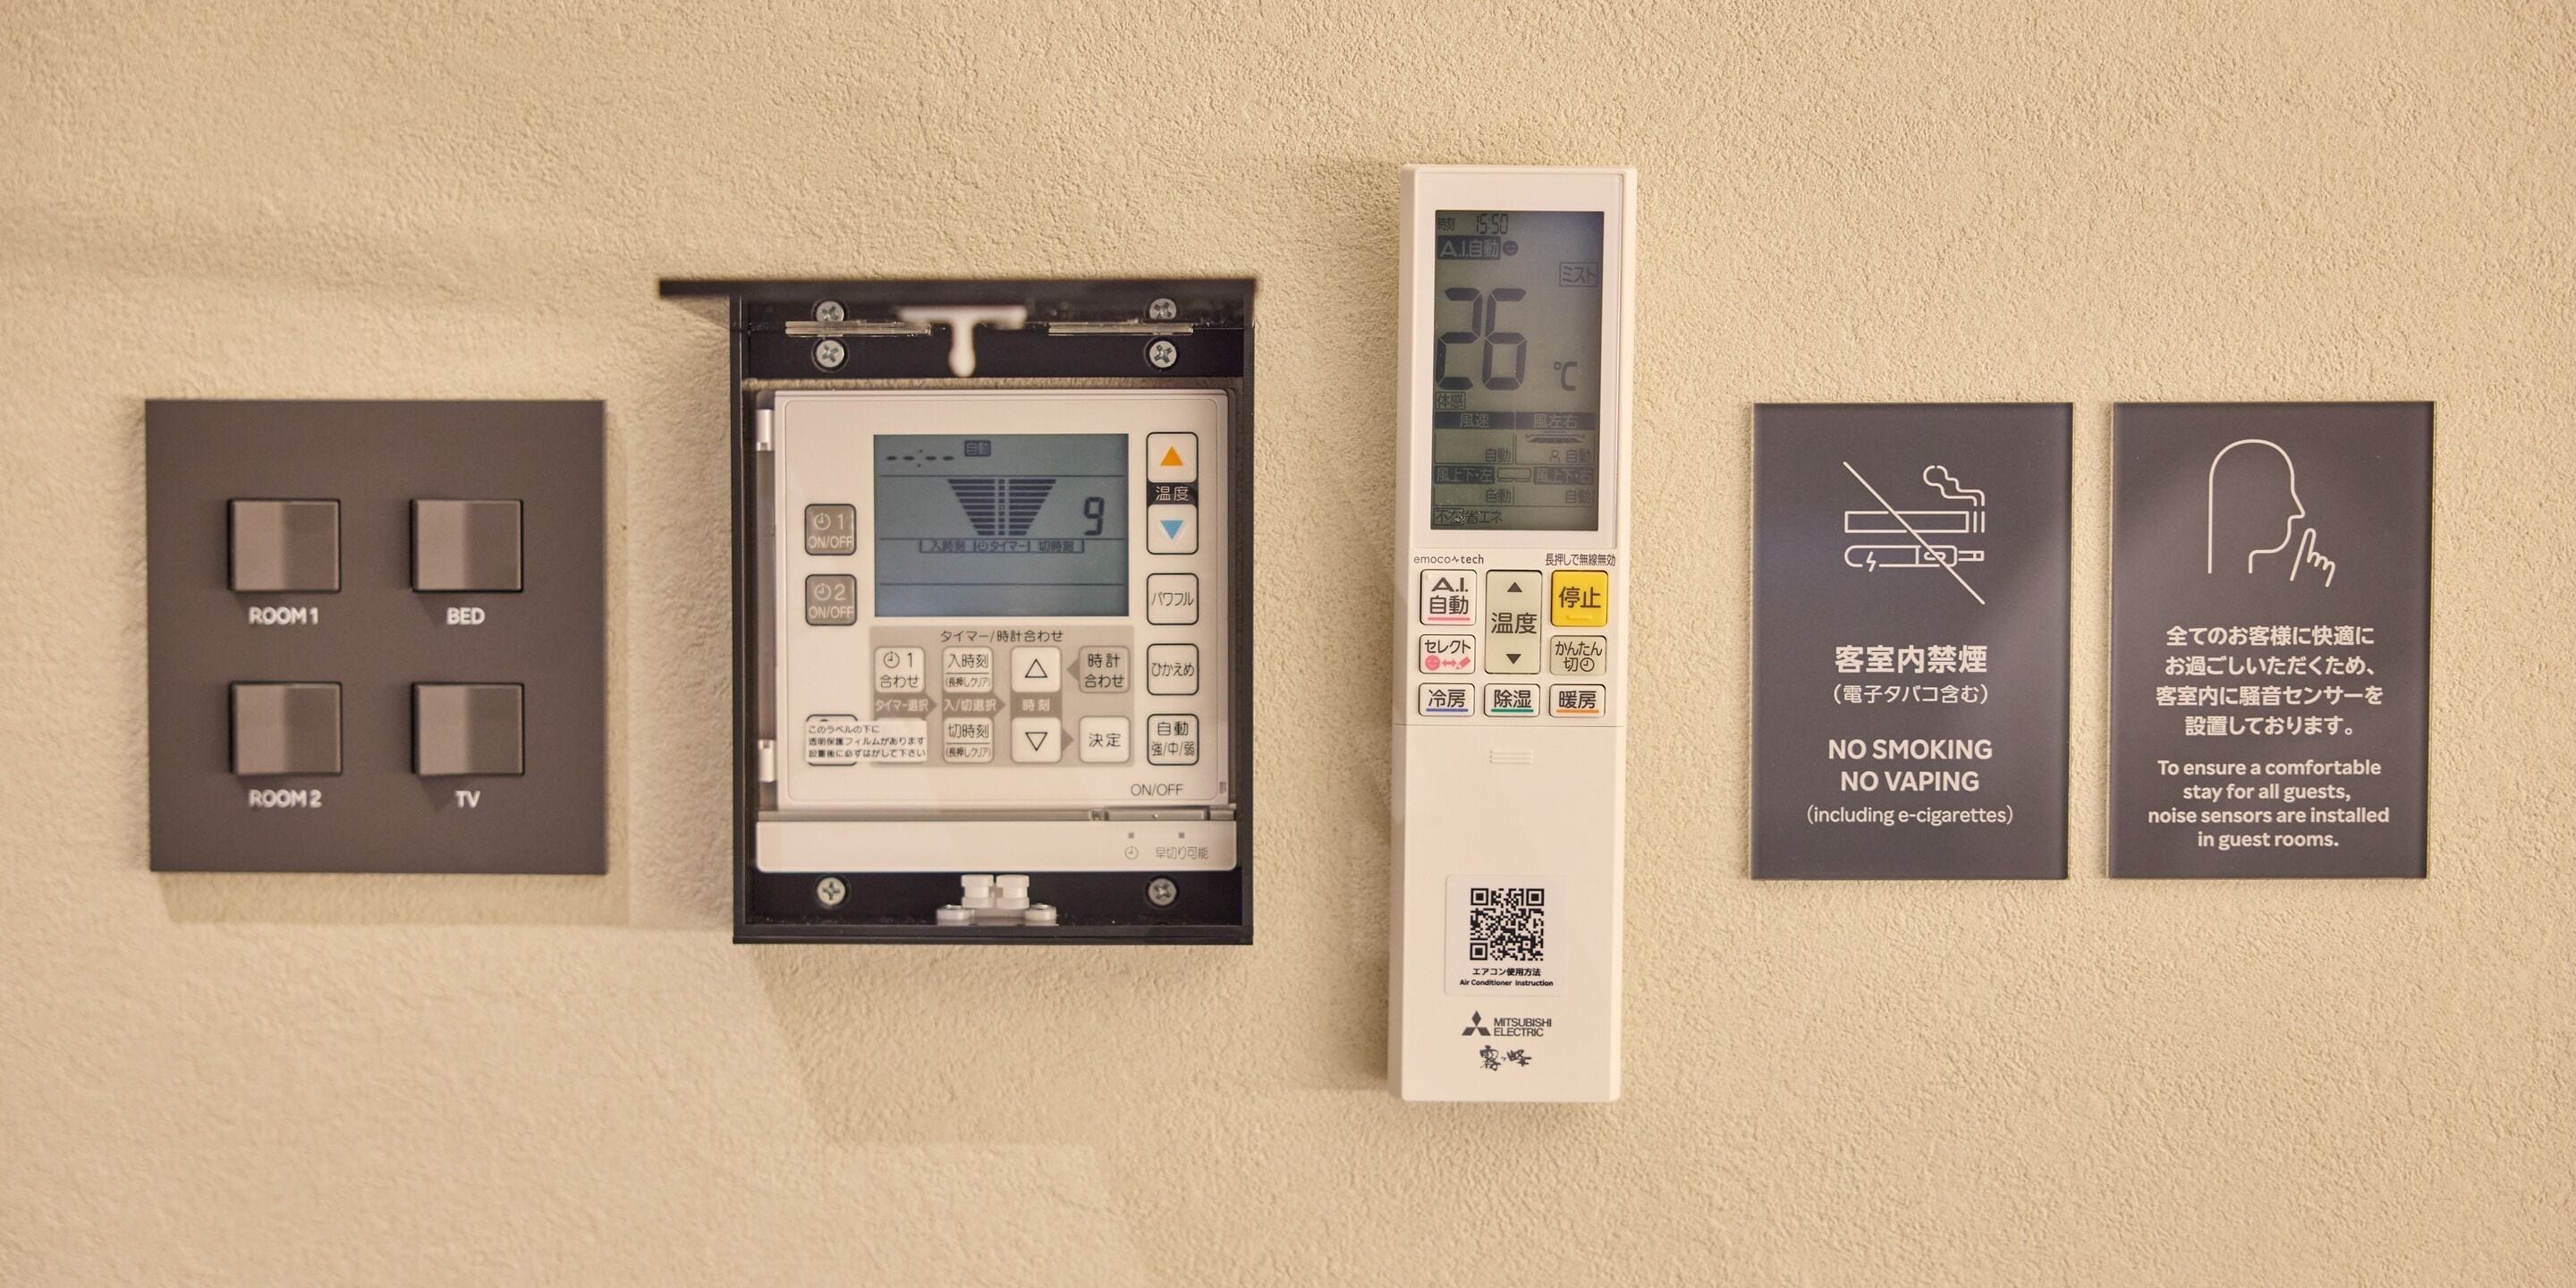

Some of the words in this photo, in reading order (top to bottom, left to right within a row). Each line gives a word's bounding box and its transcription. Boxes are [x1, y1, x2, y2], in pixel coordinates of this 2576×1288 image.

[1475, 213, 1509, 234] 15:50
[1439, 239, 1499, 258] A.I.自動
[1562, 266, 1597, 283] ミスト
[1435, 287, 1528, 391] 26
[1436, 394, 1464, 409] 体感
[1460, 413, 1489, 428] 風速
[1533, 413, 1579, 428] 風左右
[1485, 448, 1511, 462] 自動
[1565, 448, 1593, 462] 自動
[1156, 486, 1190, 502] 温度
[1486, 488, 1512, 503] 自動
[1565, 488, 1593, 504] 自動
[836, 513, 844, 530] 1
[1083, 496, 1105, 537] 9
[808, 535, 854, 549] ON/OFF
[1460, 554, 1485, 564] tech
[1545, 553, 1616, 567] 長押しで無線無効
[835, 583, 846, 601] 2
[1430, 577, 1469, 592] A.I.
[1151, 591, 1194, 606] パワフル
[1429, 595, 1469, 614] 自動
[1558, 587, 1601, 609] 停止
[249, 606, 307, 625] ROOM
[310, 607, 319, 624] 1
[447, 607, 486, 625] BED
[809, 606, 854, 619] ON/OFF
[1490, 612, 1538, 634] 温度
[940, 630, 1063, 643] タイマー/時計合わせ
[2165, 625, 2375, 647] 全てのお客様に快適に
[1424, 639, 1471, 654] セレクト
[1555, 640, 1603, 657] かんたん
[906, 652, 913, 668] 1
[947, 653, 989, 669] 入時刻
[1088, 653, 1121, 668] 時計
[1563, 657, 1579, 671] 切
[1835, 645, 1988, 674] 客室内禁煙
[2165, 656, 2376, 676] お過ごしいただくため、
[1151, 662, 1195, 677] ひかえめ
[879, 674, 919, 689] 合わせ
[1085, 674, 1124, 688] 合わせ
[1428, 689, 1466, 708] 冷房
[1494, 690, 1531, 708] 除湿
[1559, 691, 1597, 709] 暖房
[2156, 686, 2384, 707] 客室内に騒音センサーを
[875, 699, 929, 712] タイマー選択
[944, 699, 997, 712] 入/切選択
[1022, 699, 1051, 712] 時刻
[809, 724, 880, 734] このラベルの下に
[948, 723, 989, 739] 切時刻
[1157, 722, 1190, 736] 自動
[2184, 716, 2353, 736] 設置しております。
[809, 736, 925, 746] 透明保護フィルムがあります
[1089, 733, 1122, 748] 決定
[1151, 741, 1196, 757] 強/中/弱
[1828, 739, 1867, 760] NO
[1871, 739, 1993, 760] SMOKING
[2157, 760, 2180, 775] To
[2183, 763, 2247, 775] ensure
[2250, 763, 2261, 775] a
[2265, 759, 2382, 775] comfortable
[1841, 771, 1878, 792] NO
[1884, 771, 1980, 792] VAPING
[1131, 784, 1184, 796] ON/OFF
[2182, 784, 2224, 802] stay
[2226, 784, 2255, 799] for
[2258, 784, 2279, 799] all
[2284, 784, 2351, 802] guests,
[249, 790, 306, 808] ROOM
[309, 790, 322, 808] 2
[455, 791, 480, 808] TV
[1807, 805, 1894, 826] (including
[1897, 805, 2013, 826] e-cigarettes)
[2148, 808, 2198, 824] noise
[2200, 810, 2273, 824] sensors
[2275, 810, 2307, 824] are
[2310, 807, 2390, 824] installed
[2198, 831, 2215, 847] in
[2218, 832, 2271, 851] guest
[2275, 834, 2340, 847] rooms.
[1155, 846, 1209, 860] 早切り可能
[1472, 967, 1542, 977] エアコン使用方法
[1494, 1017, 1553, 1028] MITSUBISHI
[1494, 1028, 1545, 1038] ELECTRIC
